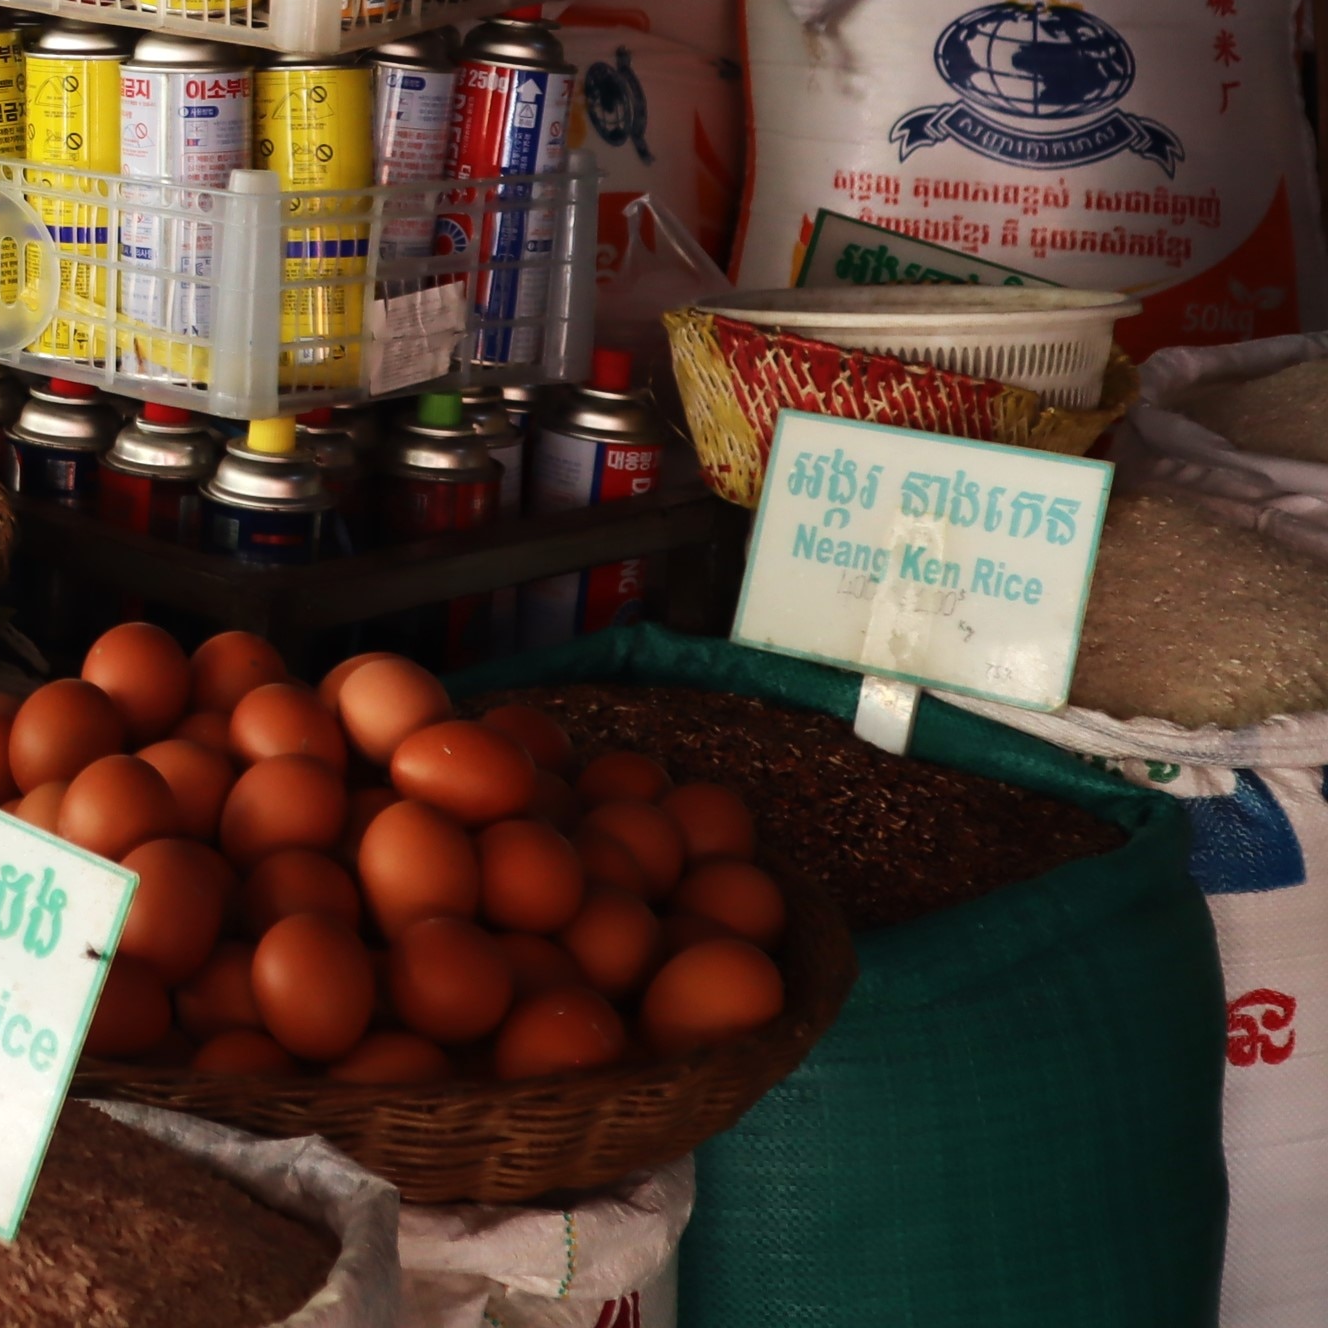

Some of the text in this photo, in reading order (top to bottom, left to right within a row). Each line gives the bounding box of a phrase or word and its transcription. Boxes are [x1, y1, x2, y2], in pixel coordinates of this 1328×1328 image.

[787, 448, 885, 529] អង្ករ
[792, 522, 890, 584] Neang
[898, 542, 962, 590] Ken
[969, 557, 1044, 606] Rice
